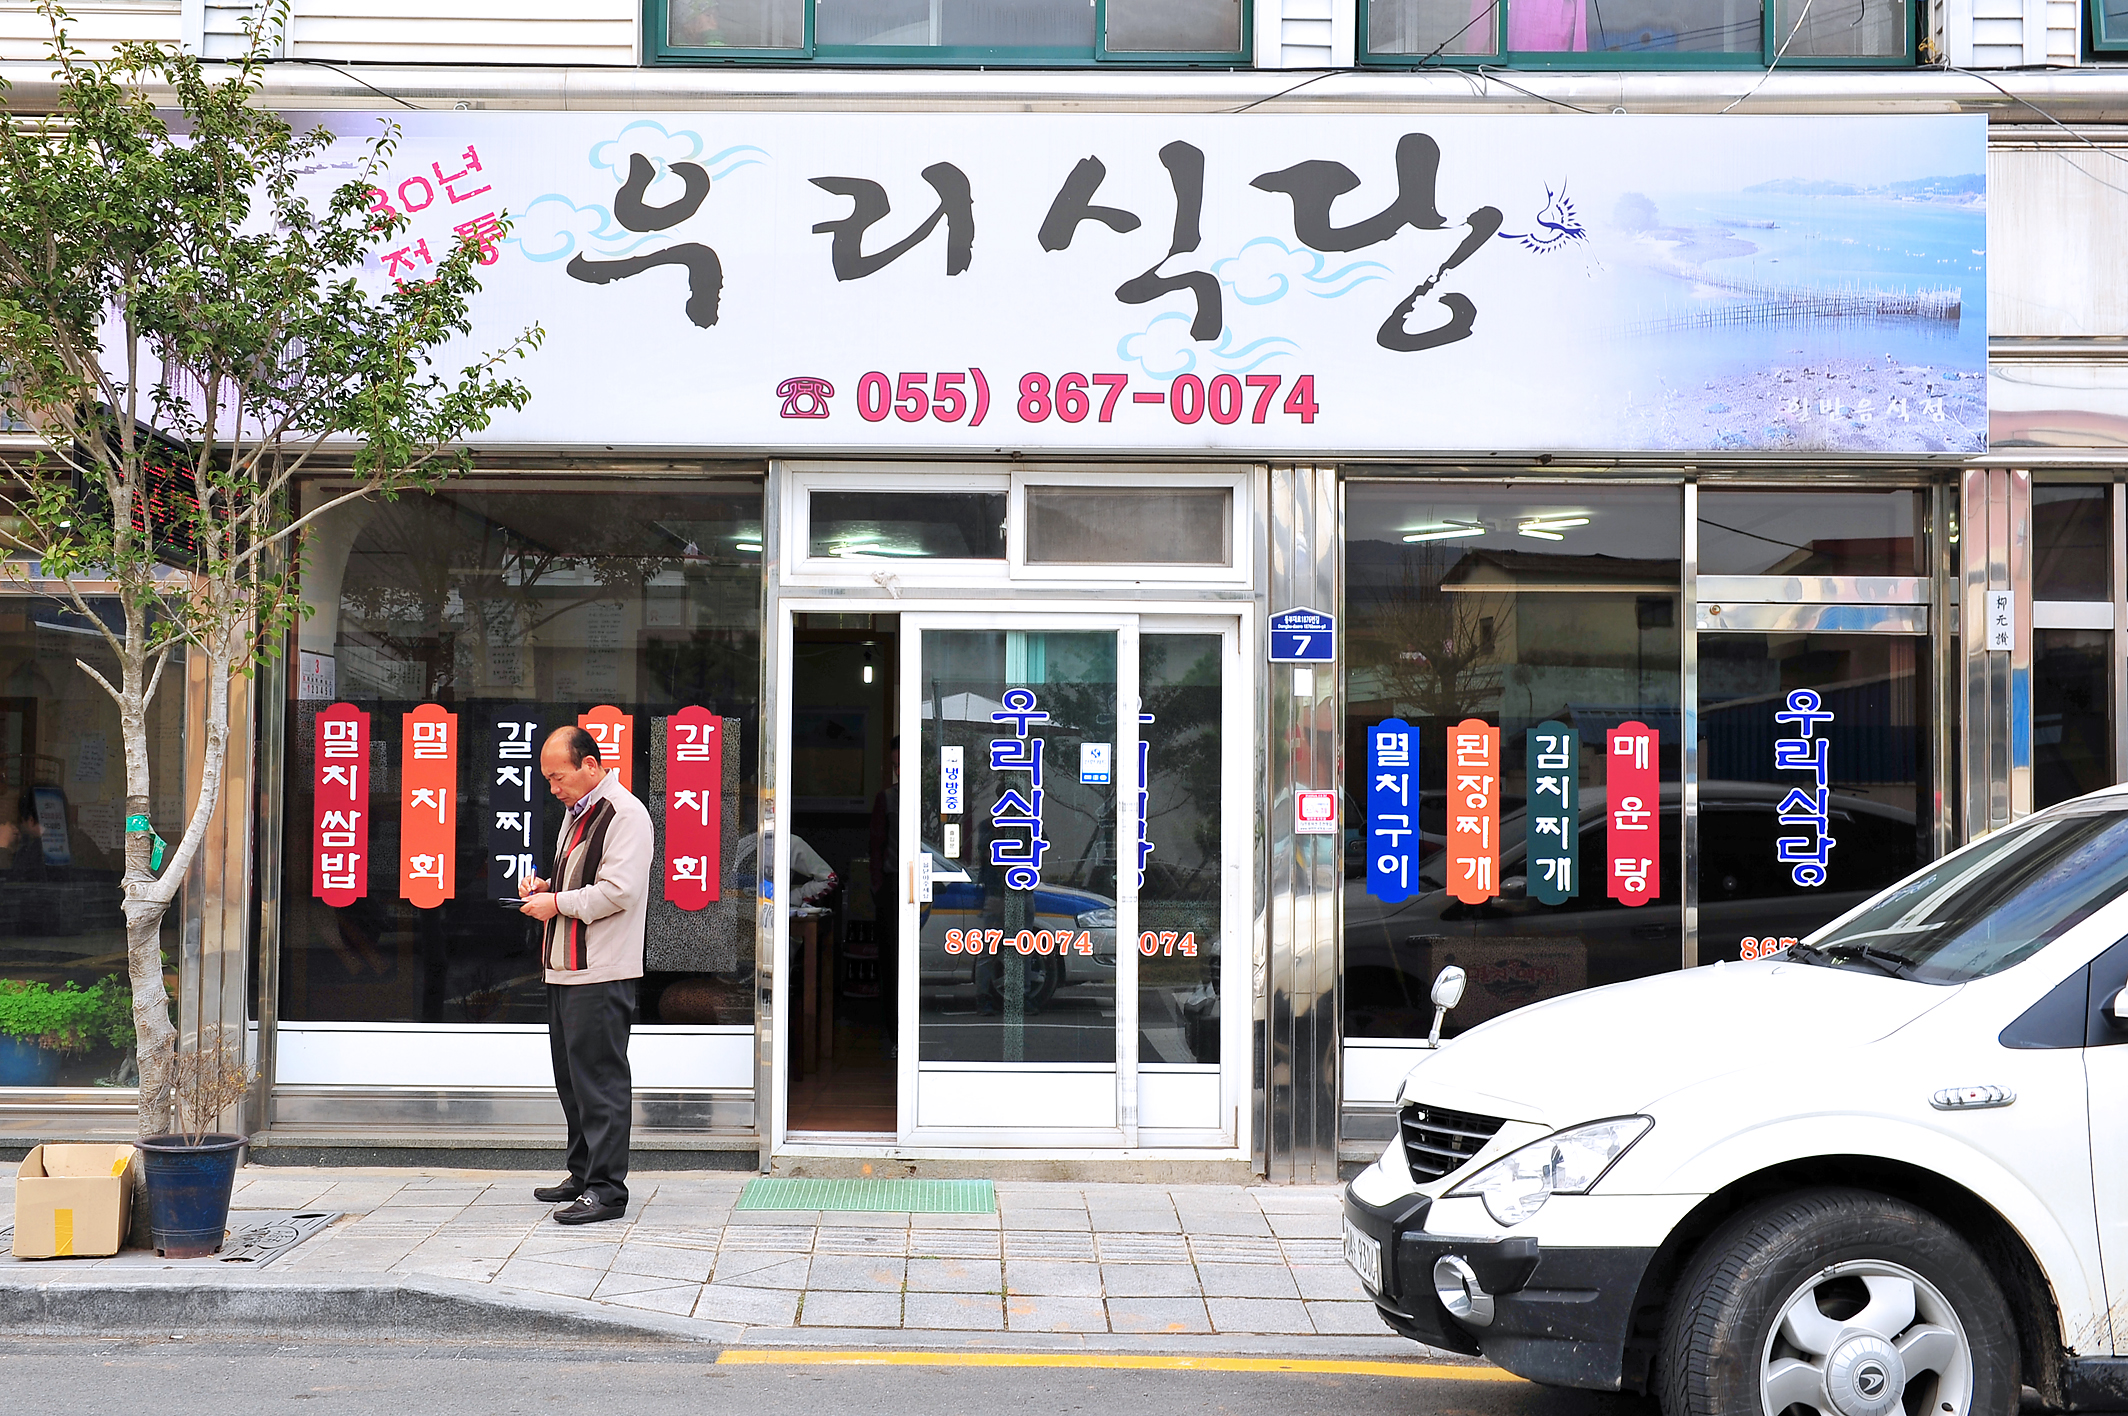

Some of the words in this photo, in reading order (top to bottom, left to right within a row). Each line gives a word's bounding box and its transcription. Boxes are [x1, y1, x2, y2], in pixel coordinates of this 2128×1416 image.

[361, 144, 492, 234] 30년
[381, 211, 505, 295] 전통
[567, 132, 1503, 353] 우리식당
[857, 367, 990, 427] 055)
[1017, 372, 1319, 425] 867-0074
[315, 659, 320, 674] 3
[1292, 635, 1312, 656] 7
[321, 721, 362, 890] 멸치쌈밥
[408, 722, 449, 890] 멸치회
[495, 721, 538, 890] 갈치찌개
[585, 723, 626, 782] 갈
[672, 724, 715, 892] 갈치회
[945, 767, 959, 810] 냉방중
[990, 688, 1051, 891] 우리식당
[1375, 732, 1413, 890] 멸치구이
[1455, 734, 1494, 891] 된장찌개
[1535, 734, 1573, 892] 김치찌개
[1613, 735, 1653, 892] 매운탕
[1776, 688, 1835, 887] 우리식당
[944, 928, 1094, 955] 867-0074
